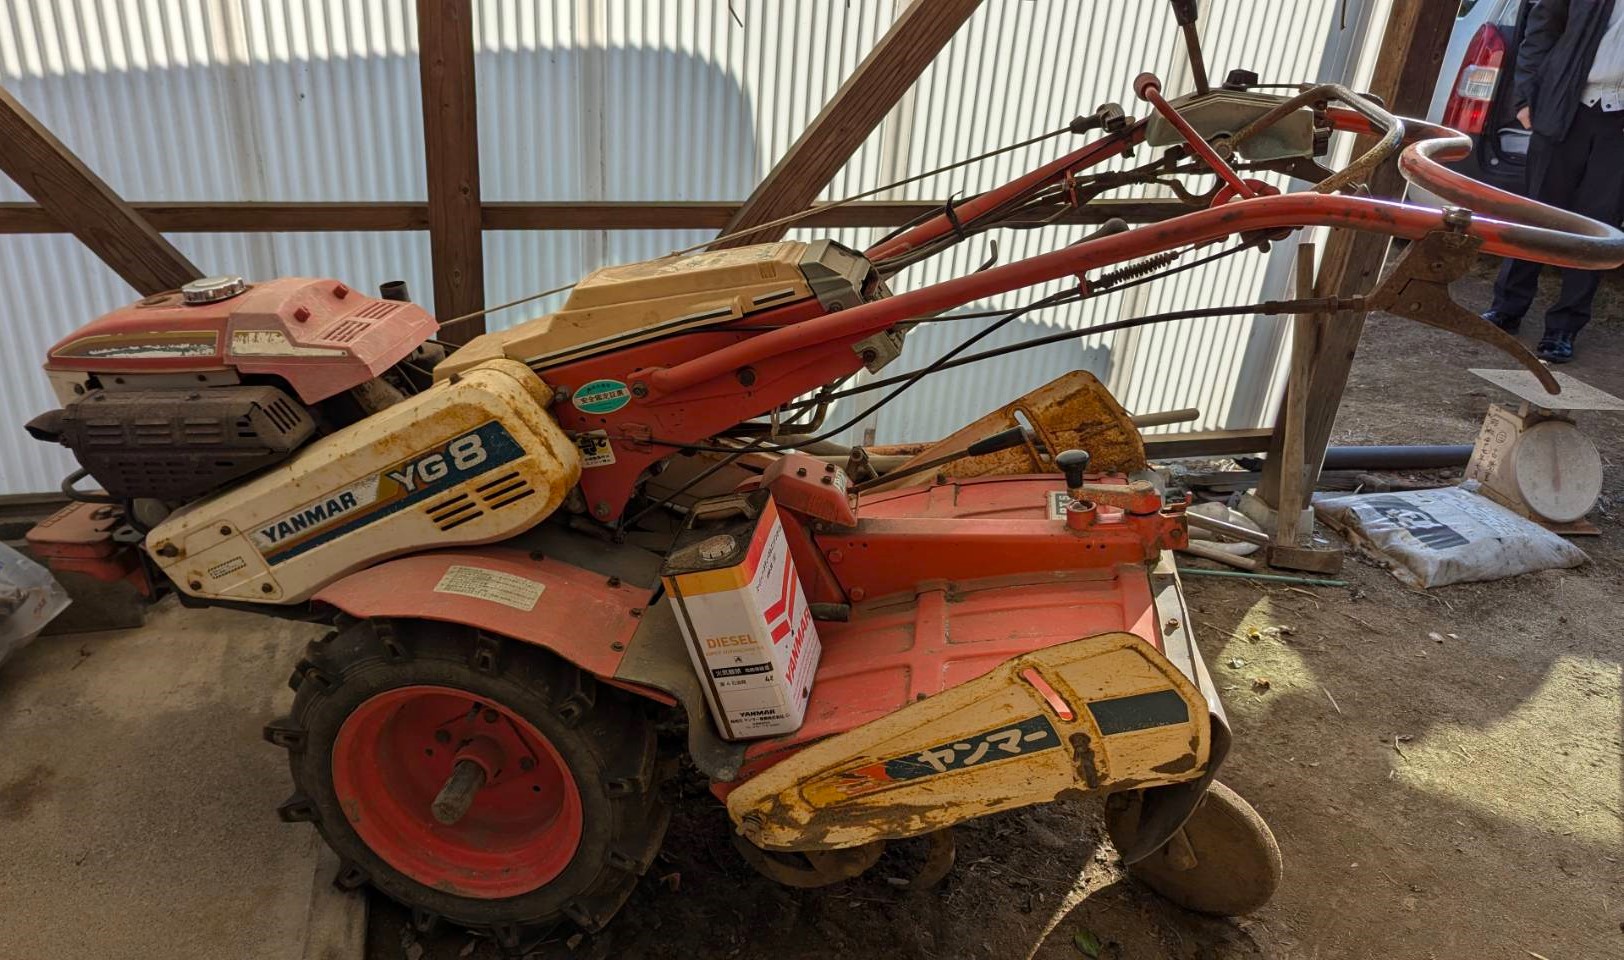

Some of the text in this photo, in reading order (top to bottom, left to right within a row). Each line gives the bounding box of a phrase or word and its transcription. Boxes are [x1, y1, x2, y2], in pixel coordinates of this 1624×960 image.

[389, 433, 488, 492] YG8
[261, 491, 358, 543] YANMAR
[706, 635, 758, 649] DIESEL
[785, 606, 811, 685] YANMAR
[740, 709, 776, 717] YANMAR
[918, 728, 1048, 772] ヤンマー
